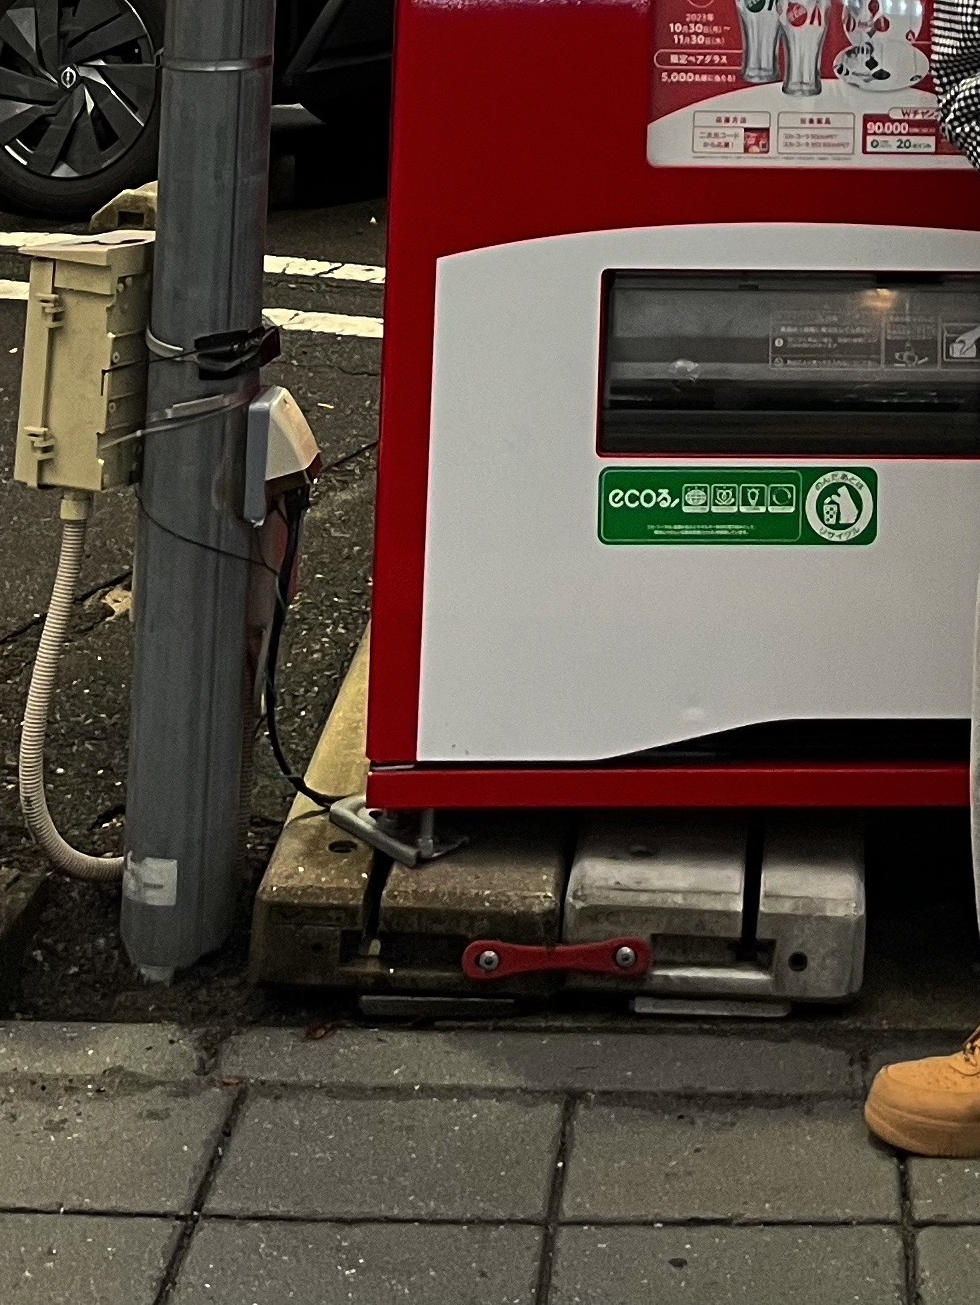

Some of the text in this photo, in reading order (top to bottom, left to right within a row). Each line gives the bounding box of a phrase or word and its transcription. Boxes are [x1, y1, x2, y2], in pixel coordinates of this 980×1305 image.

[685, 12, 715, 22] 2023年
[814, 472, 865, 492] のんだあとは
[818, 526, 861, 540] リサイクル
